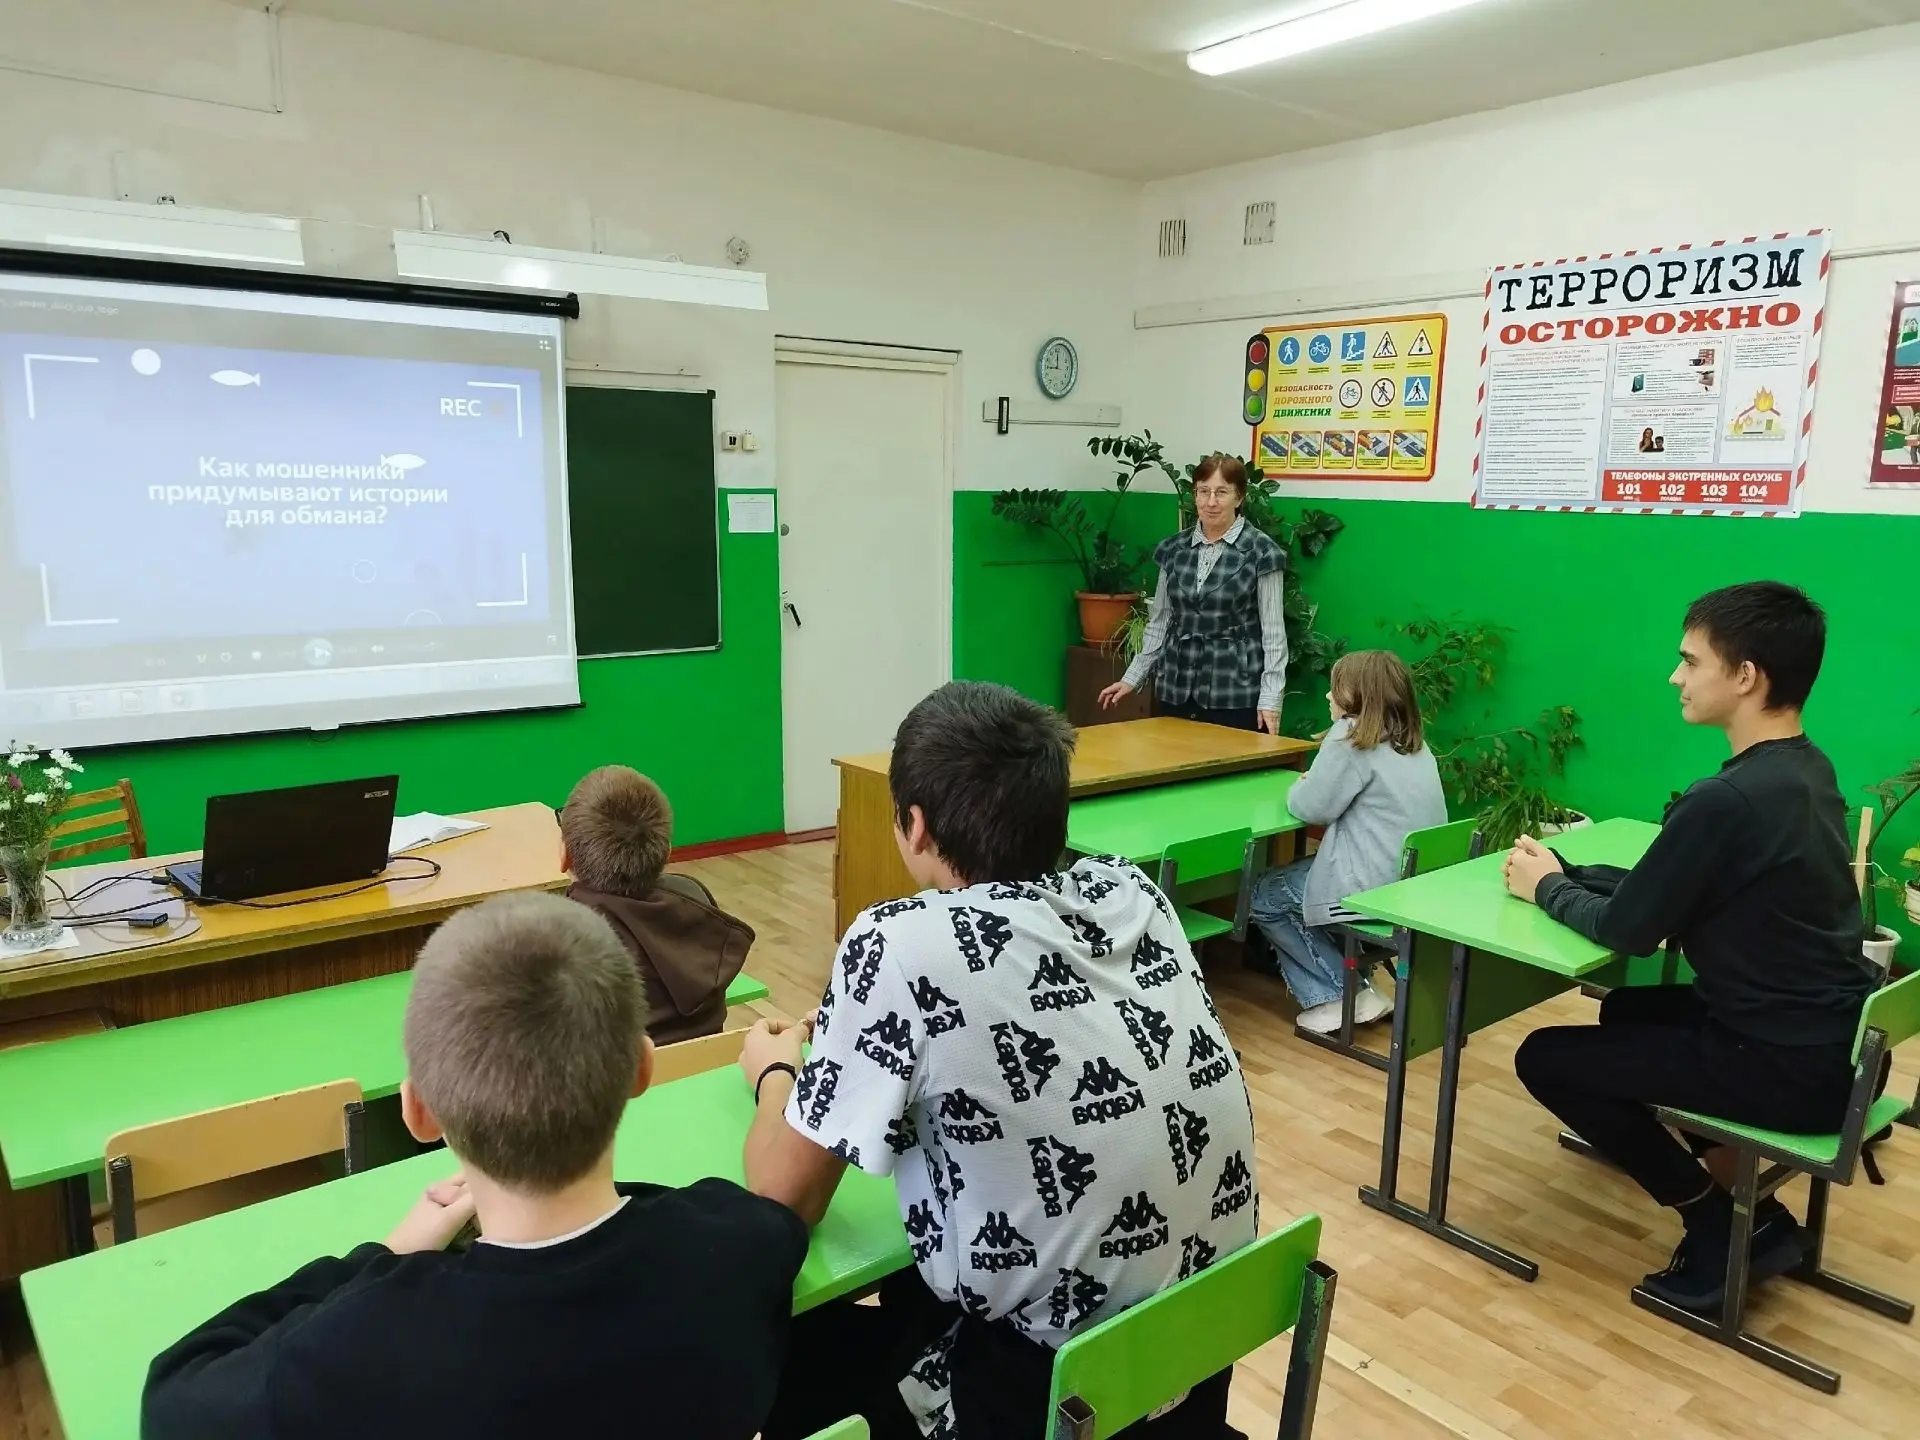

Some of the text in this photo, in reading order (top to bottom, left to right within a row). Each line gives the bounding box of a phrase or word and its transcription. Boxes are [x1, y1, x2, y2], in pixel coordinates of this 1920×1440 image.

[1498, 248, 1805, 312] ТЕРРОРИЗМ
[1500, 302, 1801, 345] ОСТОРОЖНО
[1274, 384, 1334, 392] БЕЗОПАСНОСТЬ
[440, 397, 482, 417] REC
[1273, 396, 1333, 406] ДОРОЖНОГО
[1273, 408, 1333, 418] ДВИЖЕНИЯ
[199, 456, 250, 478] Как
[1611, 471, 1783, 482] ТЕЛЕФОНЫ ЭКСТРЕННЫХ СЛУЖБ
[147, 483, 448, 507] придумывают истории
[1616, 483, 1642, 495] 101
[1658, 484, 1685, 496] 102
[1700, 484, 1728, 497] 103
[1739, 485, 1768, 497] 104
[225, 504, 388, 528] для обмана?
[947, 907, 986, 973] Kappa
[1113, 999, 1160, 1072] Kappa
[854, 1033, 914, 1081] Kappa
[988, 1022, 1031, 1104] Kappa
[1162, 1102, 1189, 1186] Kappa
[1026, 1136, 1063, 1218] Kappa
